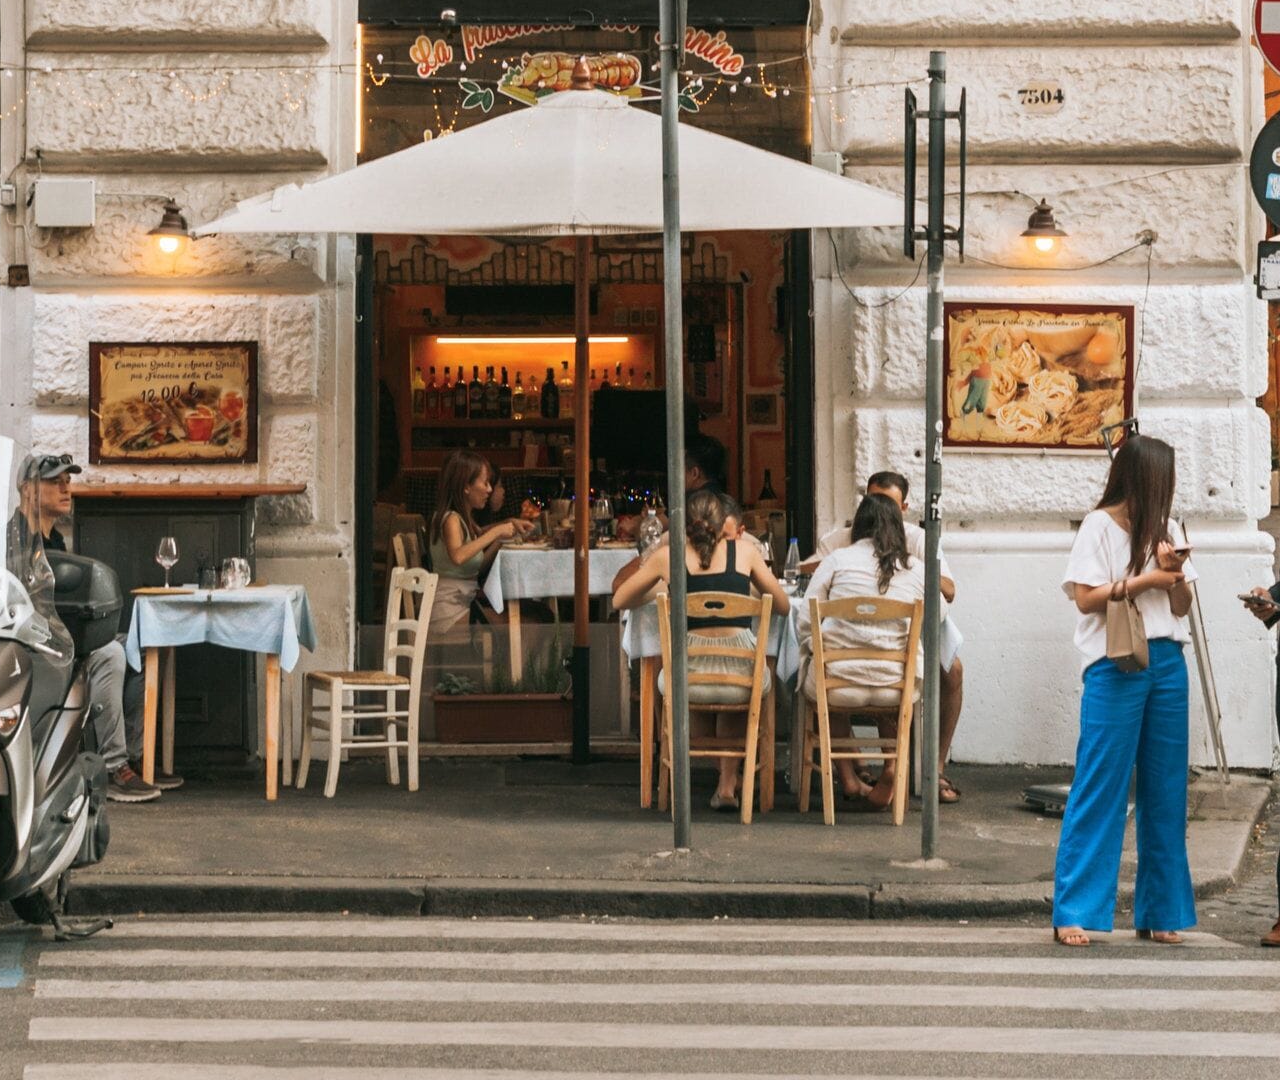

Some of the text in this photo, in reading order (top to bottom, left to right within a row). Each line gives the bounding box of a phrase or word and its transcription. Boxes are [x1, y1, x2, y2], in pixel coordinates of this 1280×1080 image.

[410, 25, 745, 78] La frasc nino
[1017, 88, 1065, 105] 7504
